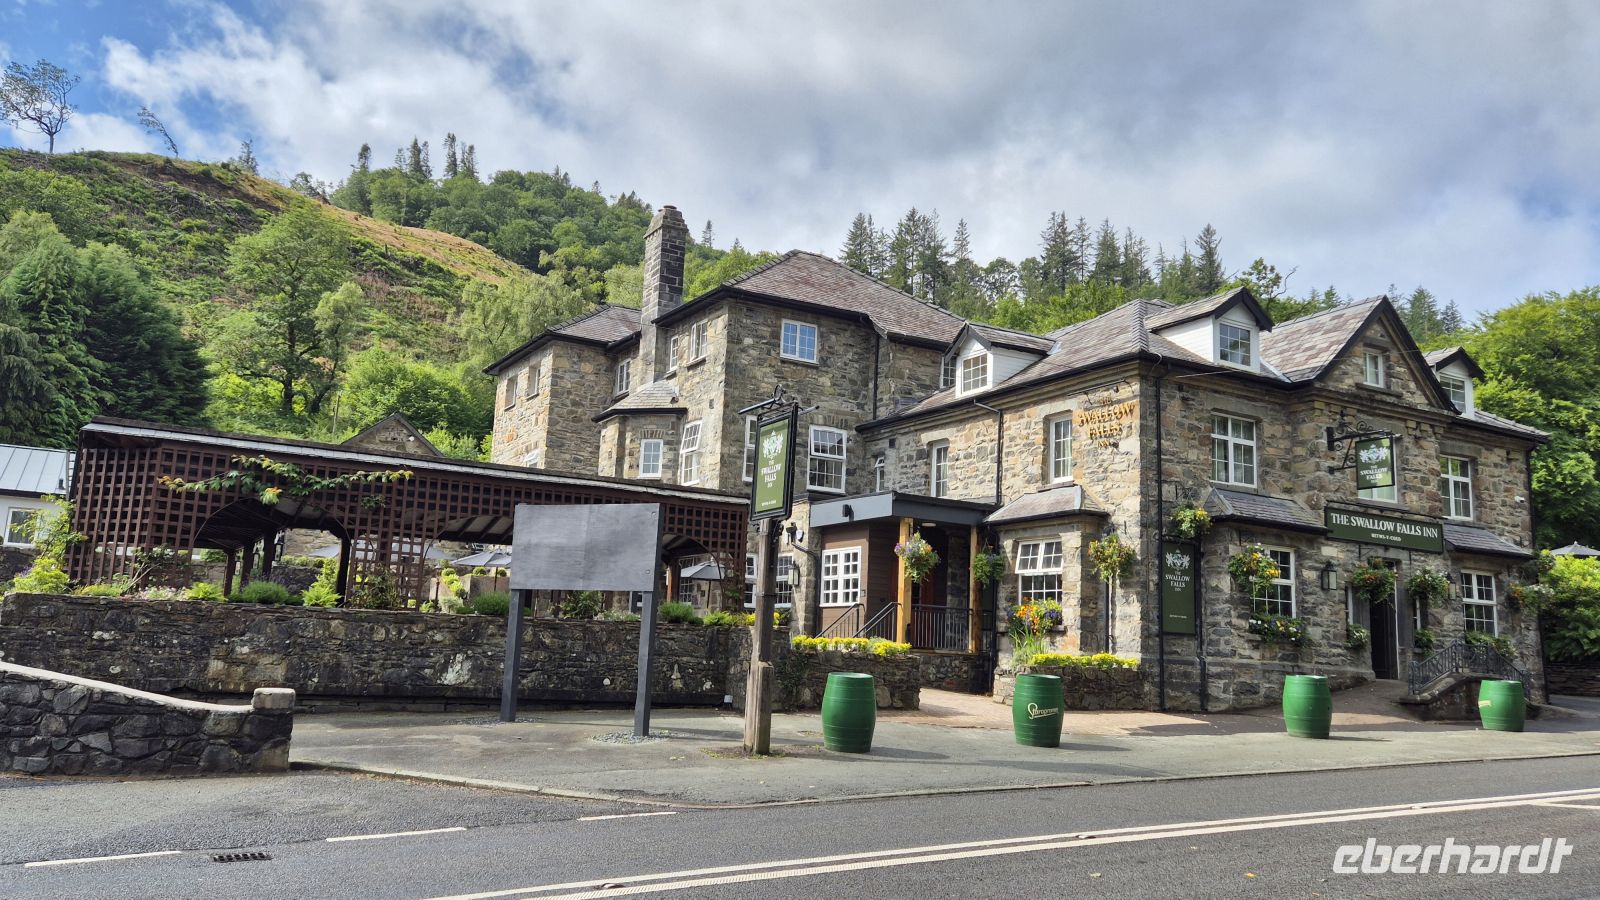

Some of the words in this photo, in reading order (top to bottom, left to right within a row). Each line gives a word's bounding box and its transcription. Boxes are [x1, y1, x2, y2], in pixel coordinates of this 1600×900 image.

[1078, 402, 1135, 426] SWALLOW
[1088, 423, 1123, 440] FALLS
[761, 464, 781, 476] SWALLOW
[1360, 467, 1388, 475] SWALLOW
[764, 473, 777, 483] FALLS
[1331, 513, 1349, 526] THE
[1350, 516, 1395, 533] SWALLOW
[1396, 523, 1421, 536] FALLS
[1422, 526, 1438, 539] INN
[1165, 574, 1191, 583] SWALLOW
